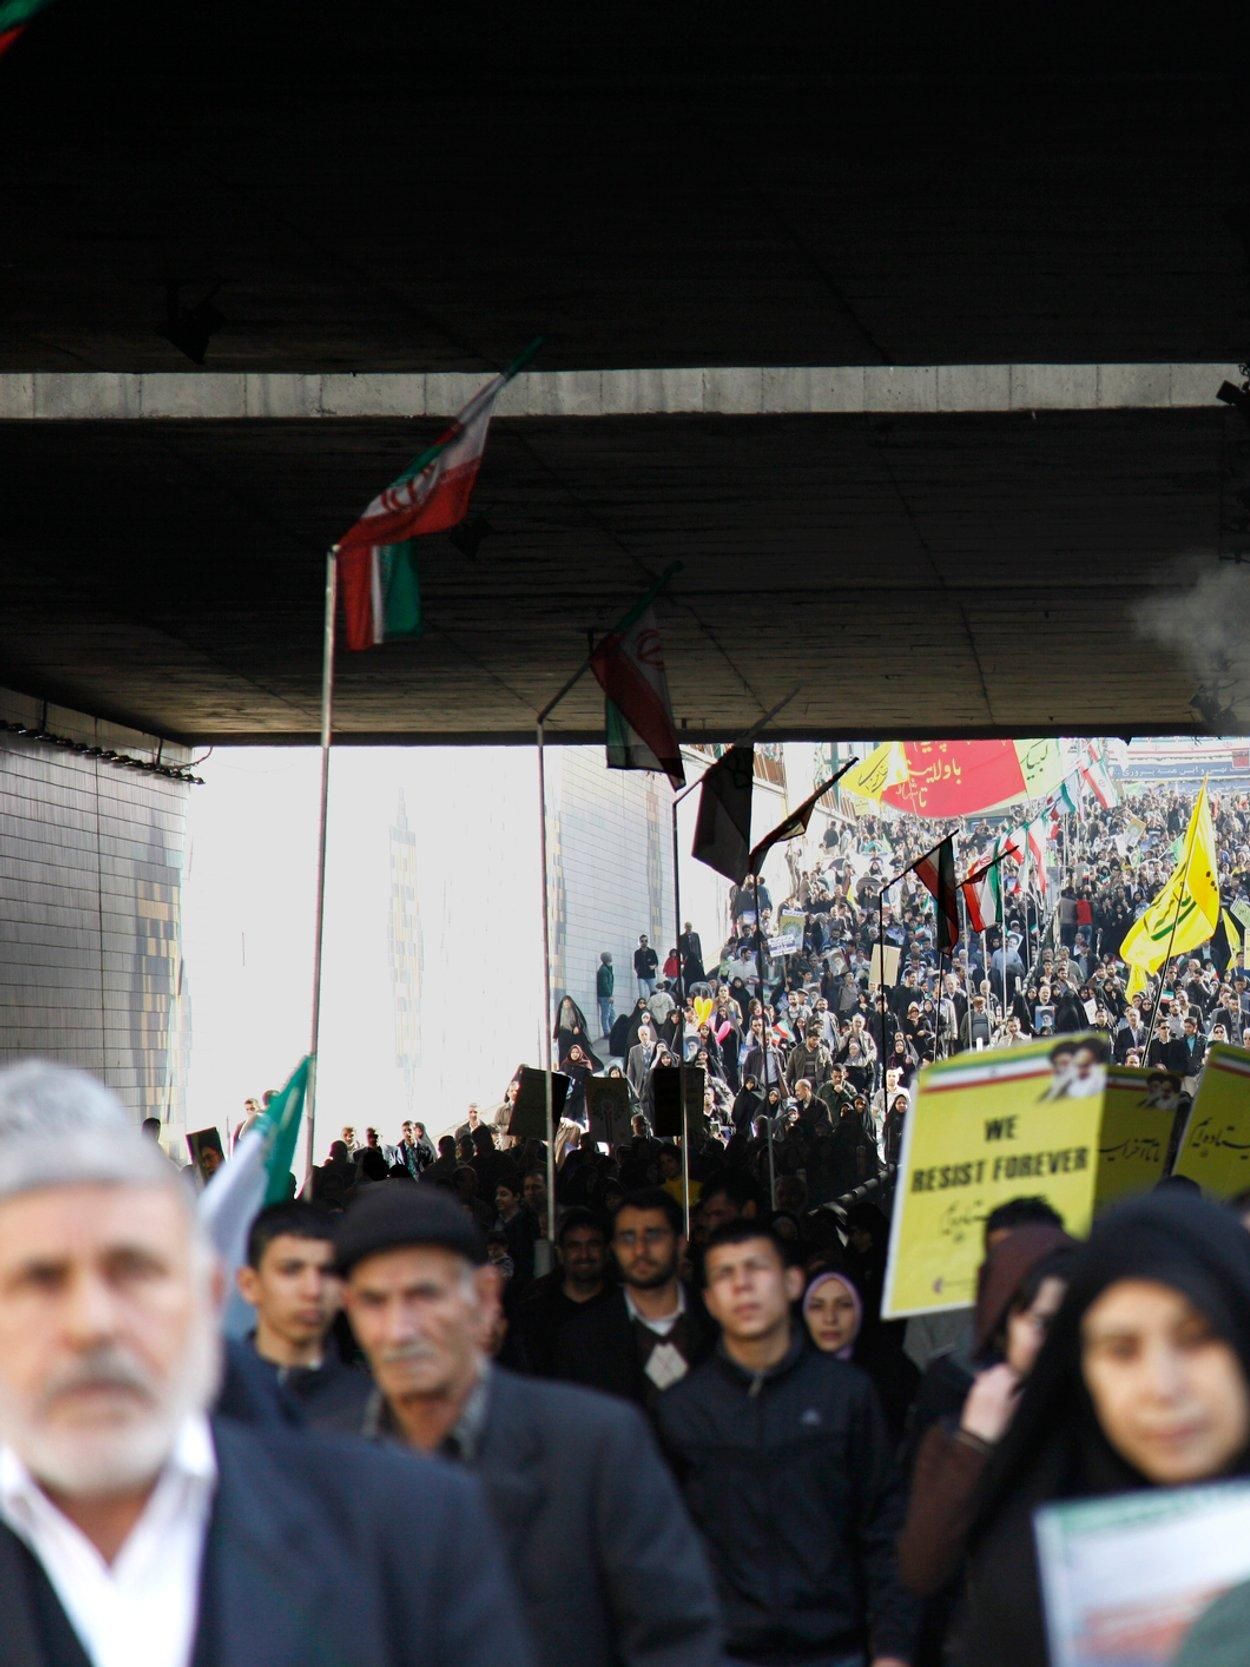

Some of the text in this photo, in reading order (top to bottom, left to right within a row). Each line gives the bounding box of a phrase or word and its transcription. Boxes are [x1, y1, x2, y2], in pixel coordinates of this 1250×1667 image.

[984, 1114, 1018, 1142] WE
[911, 1159, 986, 1195] RESIST
[991, 1146, 1089, 1182] FOREVER
